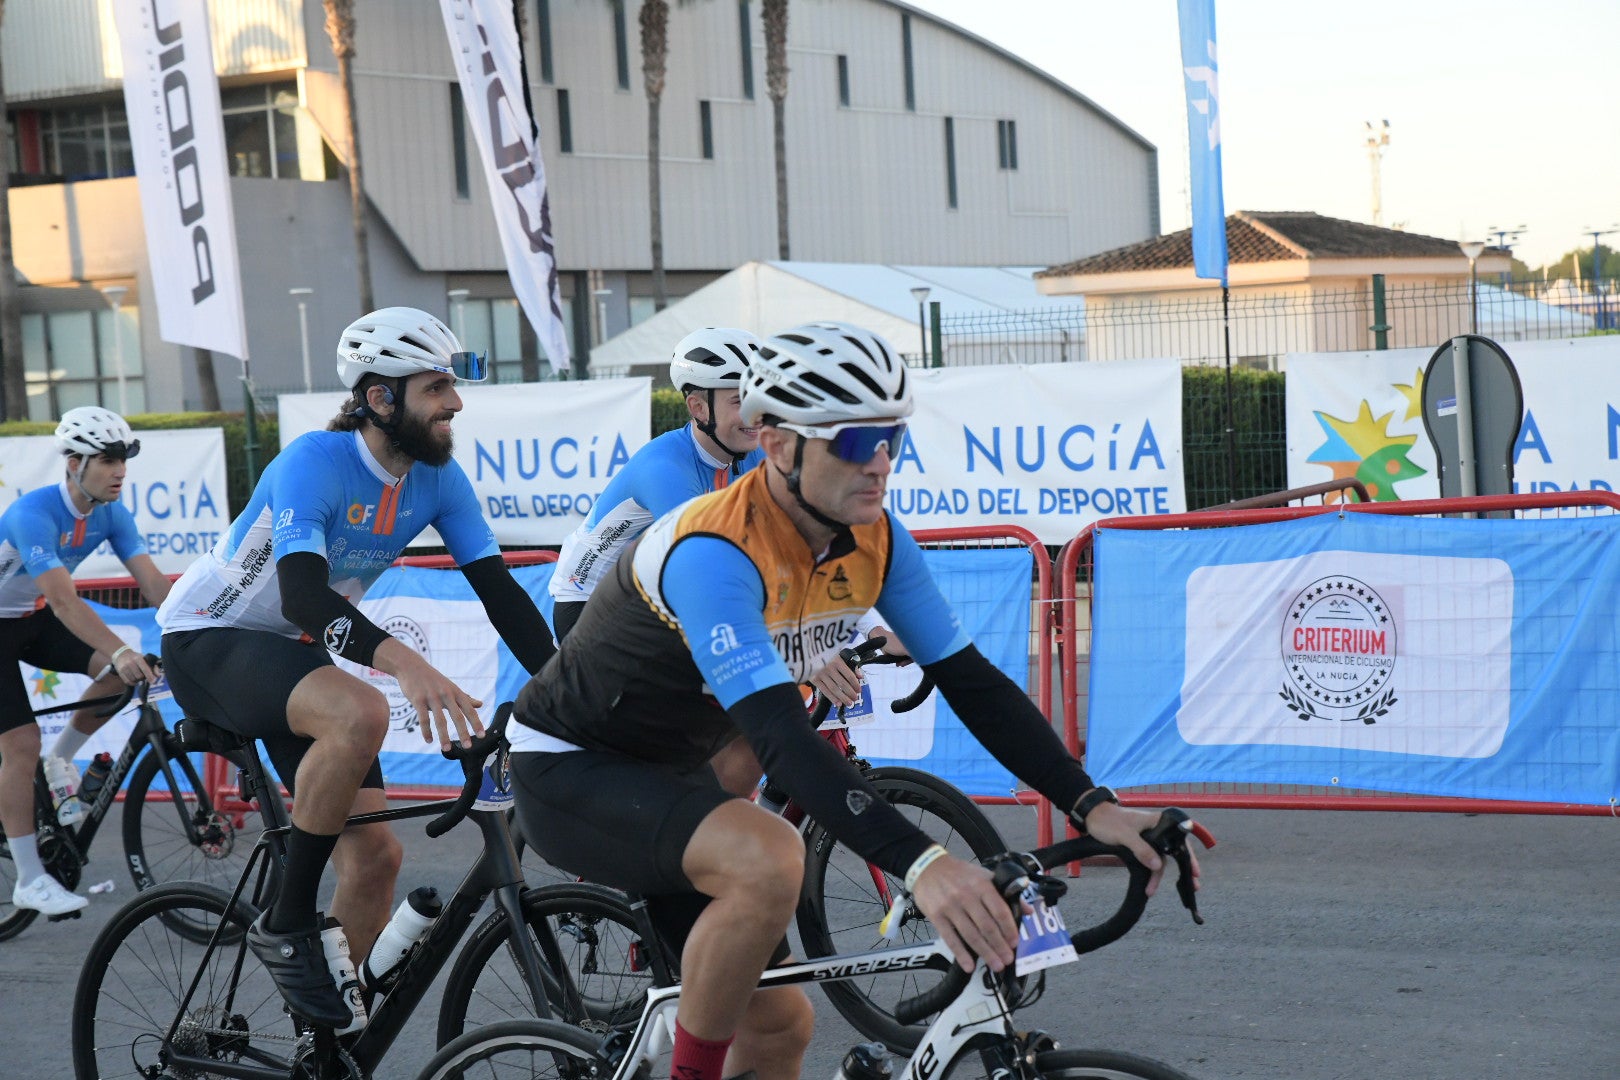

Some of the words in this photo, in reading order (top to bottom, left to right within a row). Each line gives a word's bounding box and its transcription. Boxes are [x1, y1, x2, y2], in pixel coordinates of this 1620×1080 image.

[893, 426, 926, 474] A
[1512, 408, 1553, 465] A
[486, 494, 529, 520] DEL
[532, 492, 601, 518] DEPO
[884, 488, 969, 515] IUDAD
[977, 488, 1028, 515] DEL
[1038, 486, 1170, 515] DEPORTE
[141, 531, 220, 555] EPORTE
[1293, 626, 1387, 656] CRITERIUM
[1287, 654, 1343, 665] INTERNACIONAL
[1344, 655, 1355, 665] DE
[1356, 657, 1392, 668] CICLISMO
[1316, 671, 1326, 680] LA
